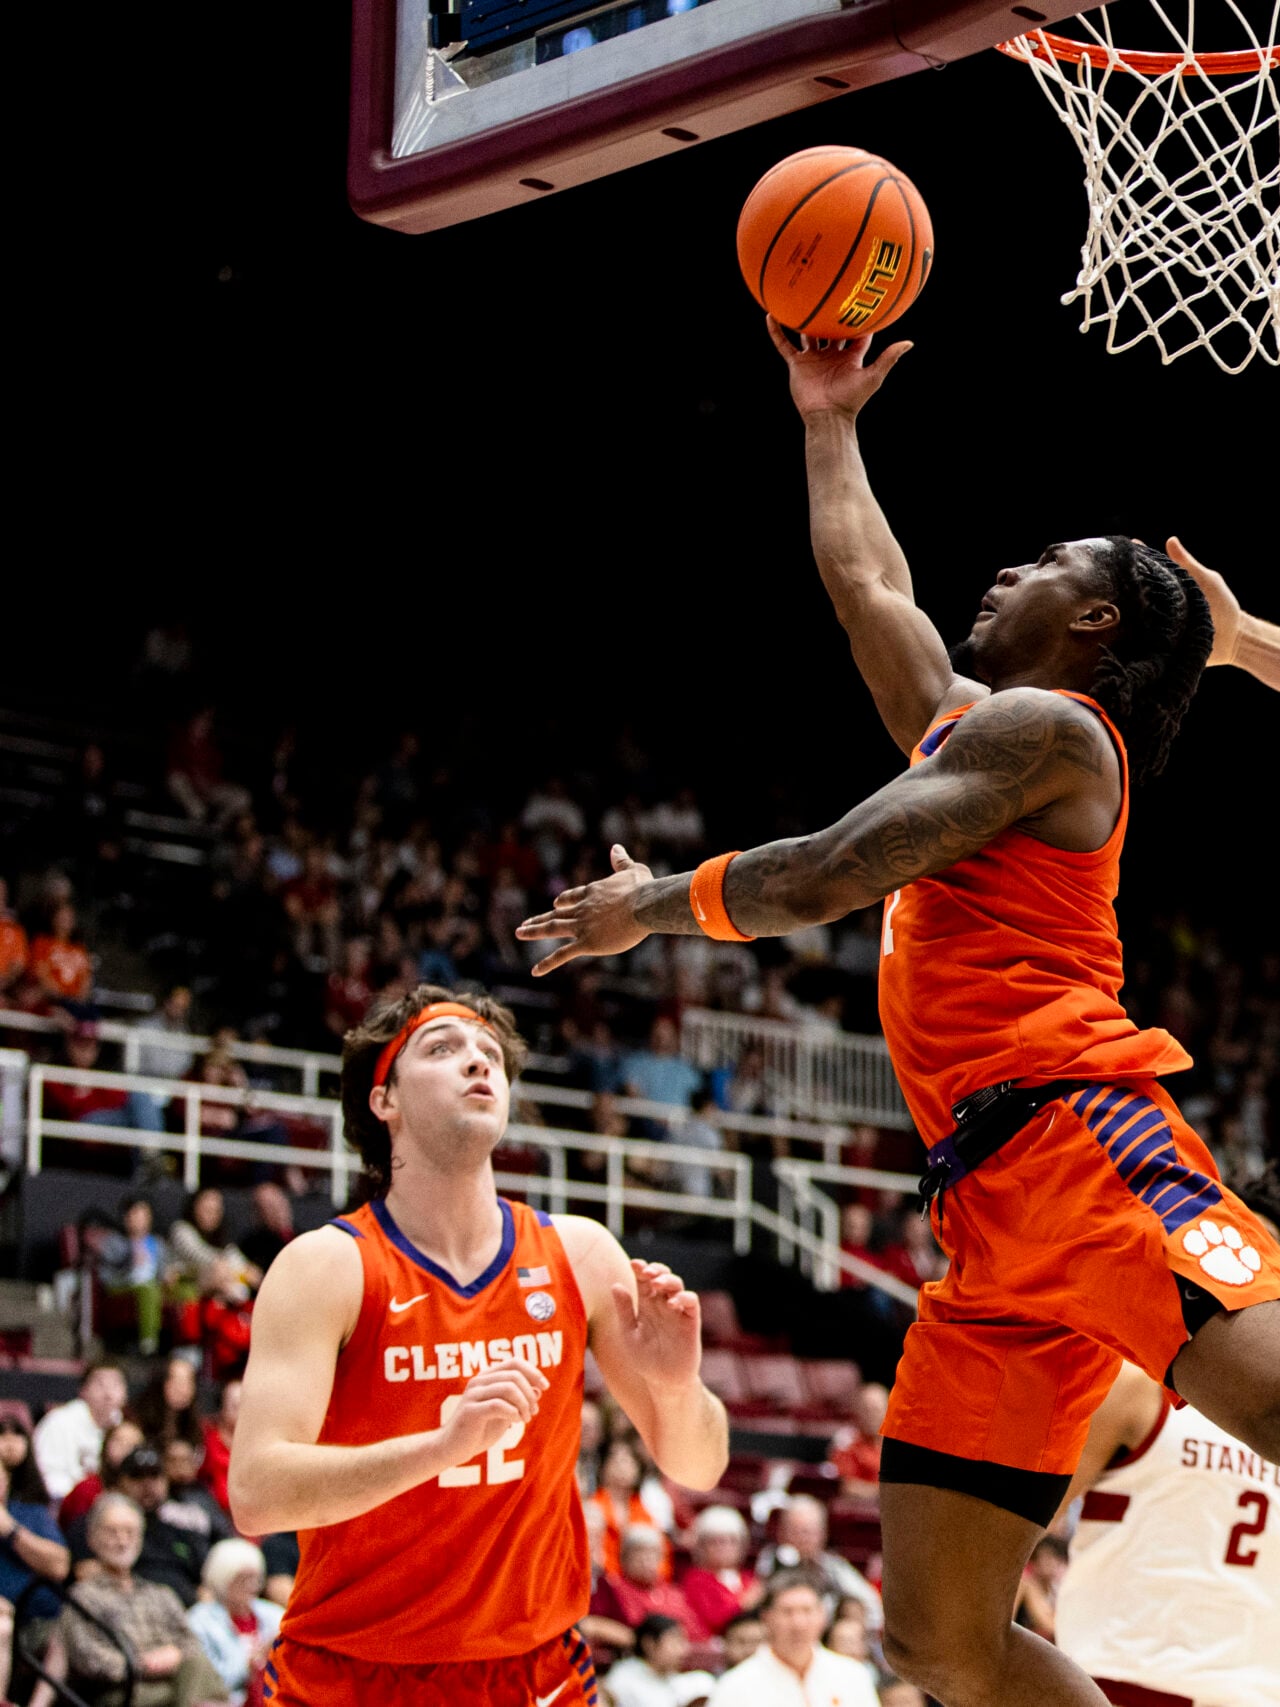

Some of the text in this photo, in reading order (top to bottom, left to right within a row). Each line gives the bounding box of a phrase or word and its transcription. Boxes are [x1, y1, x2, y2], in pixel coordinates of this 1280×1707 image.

[838, 240, 903, 329] ELITE
[384, 1330, 564, 1383] CLEMSON
[1224, 1490, 1270, 1567] 2
